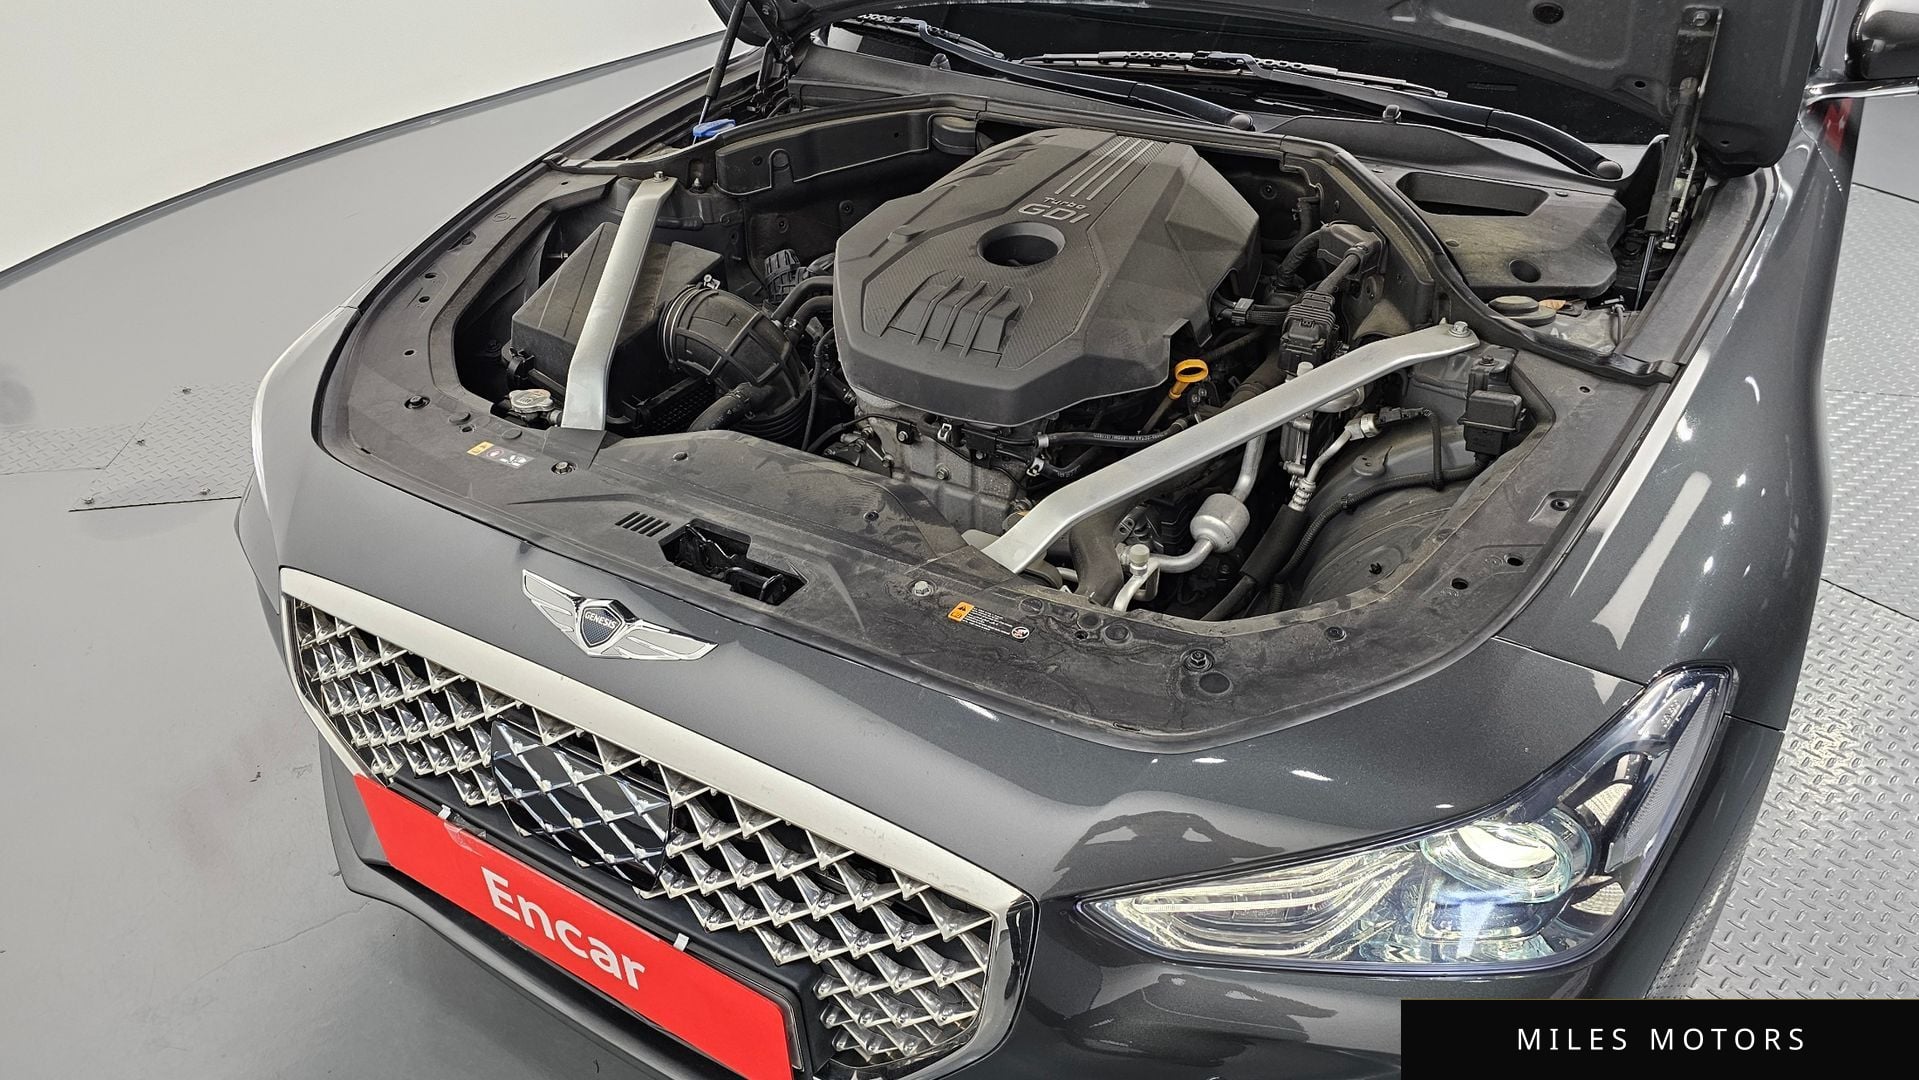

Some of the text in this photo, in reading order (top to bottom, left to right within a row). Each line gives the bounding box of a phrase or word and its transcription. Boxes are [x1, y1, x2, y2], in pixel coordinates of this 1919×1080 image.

[1044, 196, 1087, 210] Turbo
[1018, 203, 1090, 223] GDI
[585, 611, 617, 629] GENESIS
[481, 866, 645, 990] Encar
